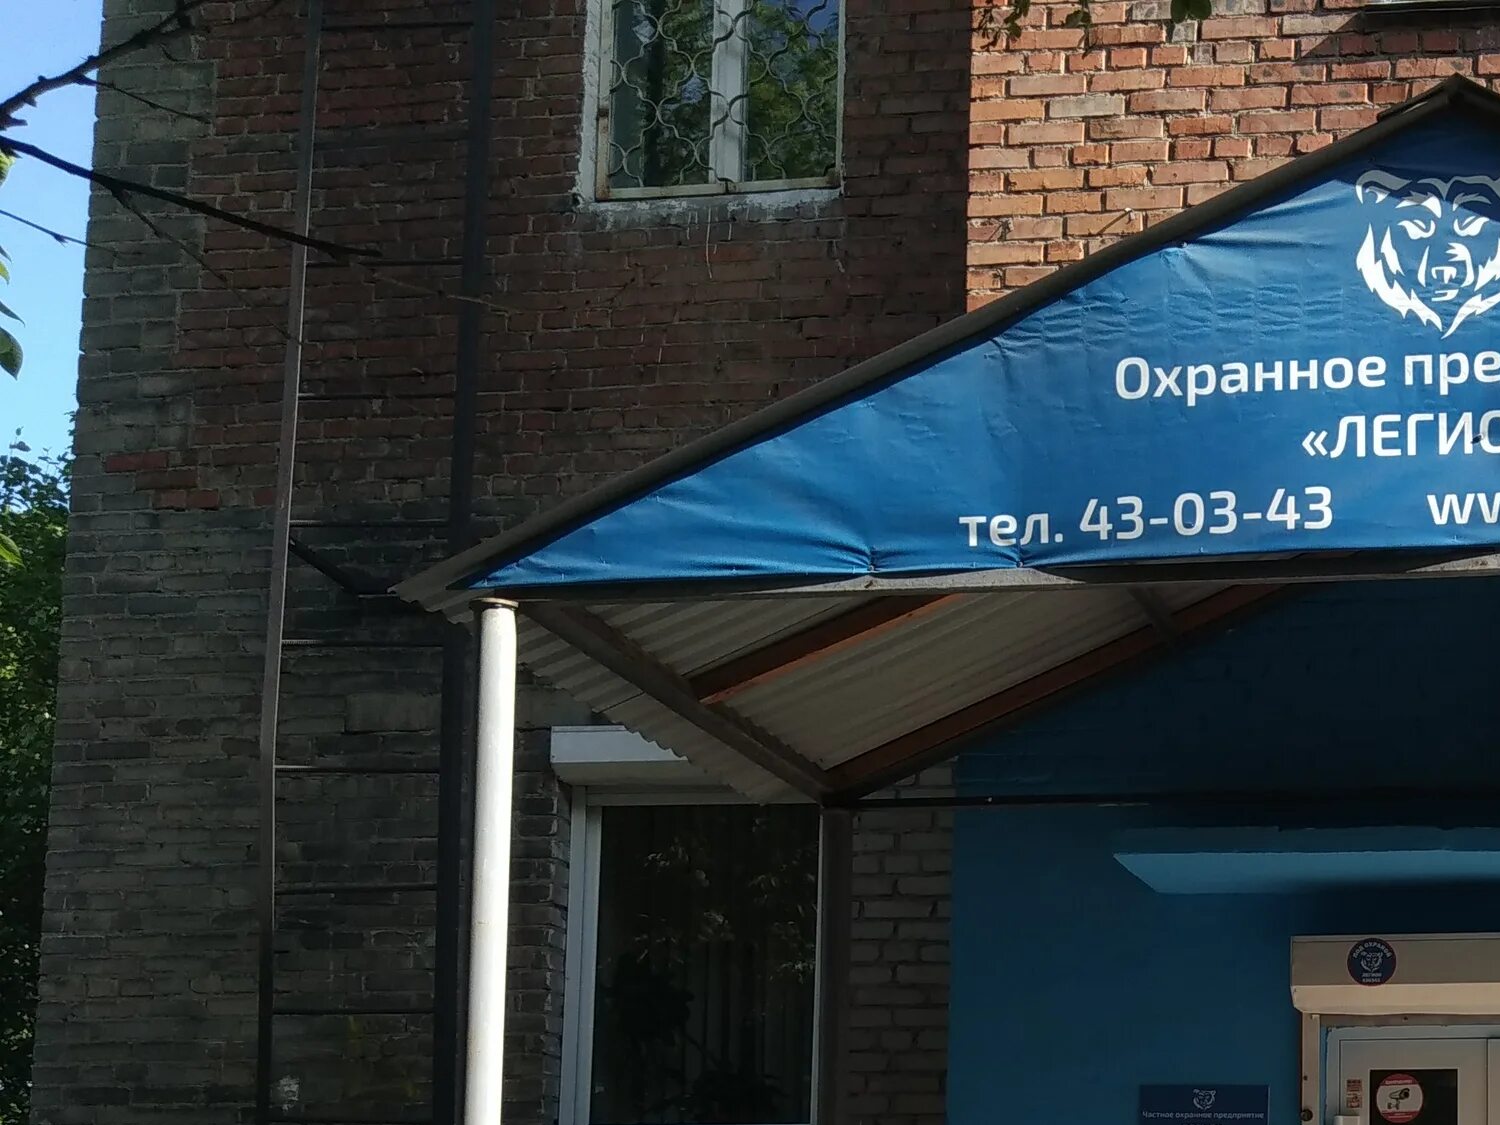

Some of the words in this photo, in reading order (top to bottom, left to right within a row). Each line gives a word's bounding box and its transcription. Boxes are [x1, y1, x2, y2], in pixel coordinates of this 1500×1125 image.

[1114, 355, 1387, 406] Охранное
[958, 512, 1064, 547] тел.
[1079, 486, 1333, 541] 43-03-43
[1142, 1111, 1174, 1119] Частное
[1175, 1112, 1212, 1120] охранное
[1213, 1112, 1265, 1121] предприятие
